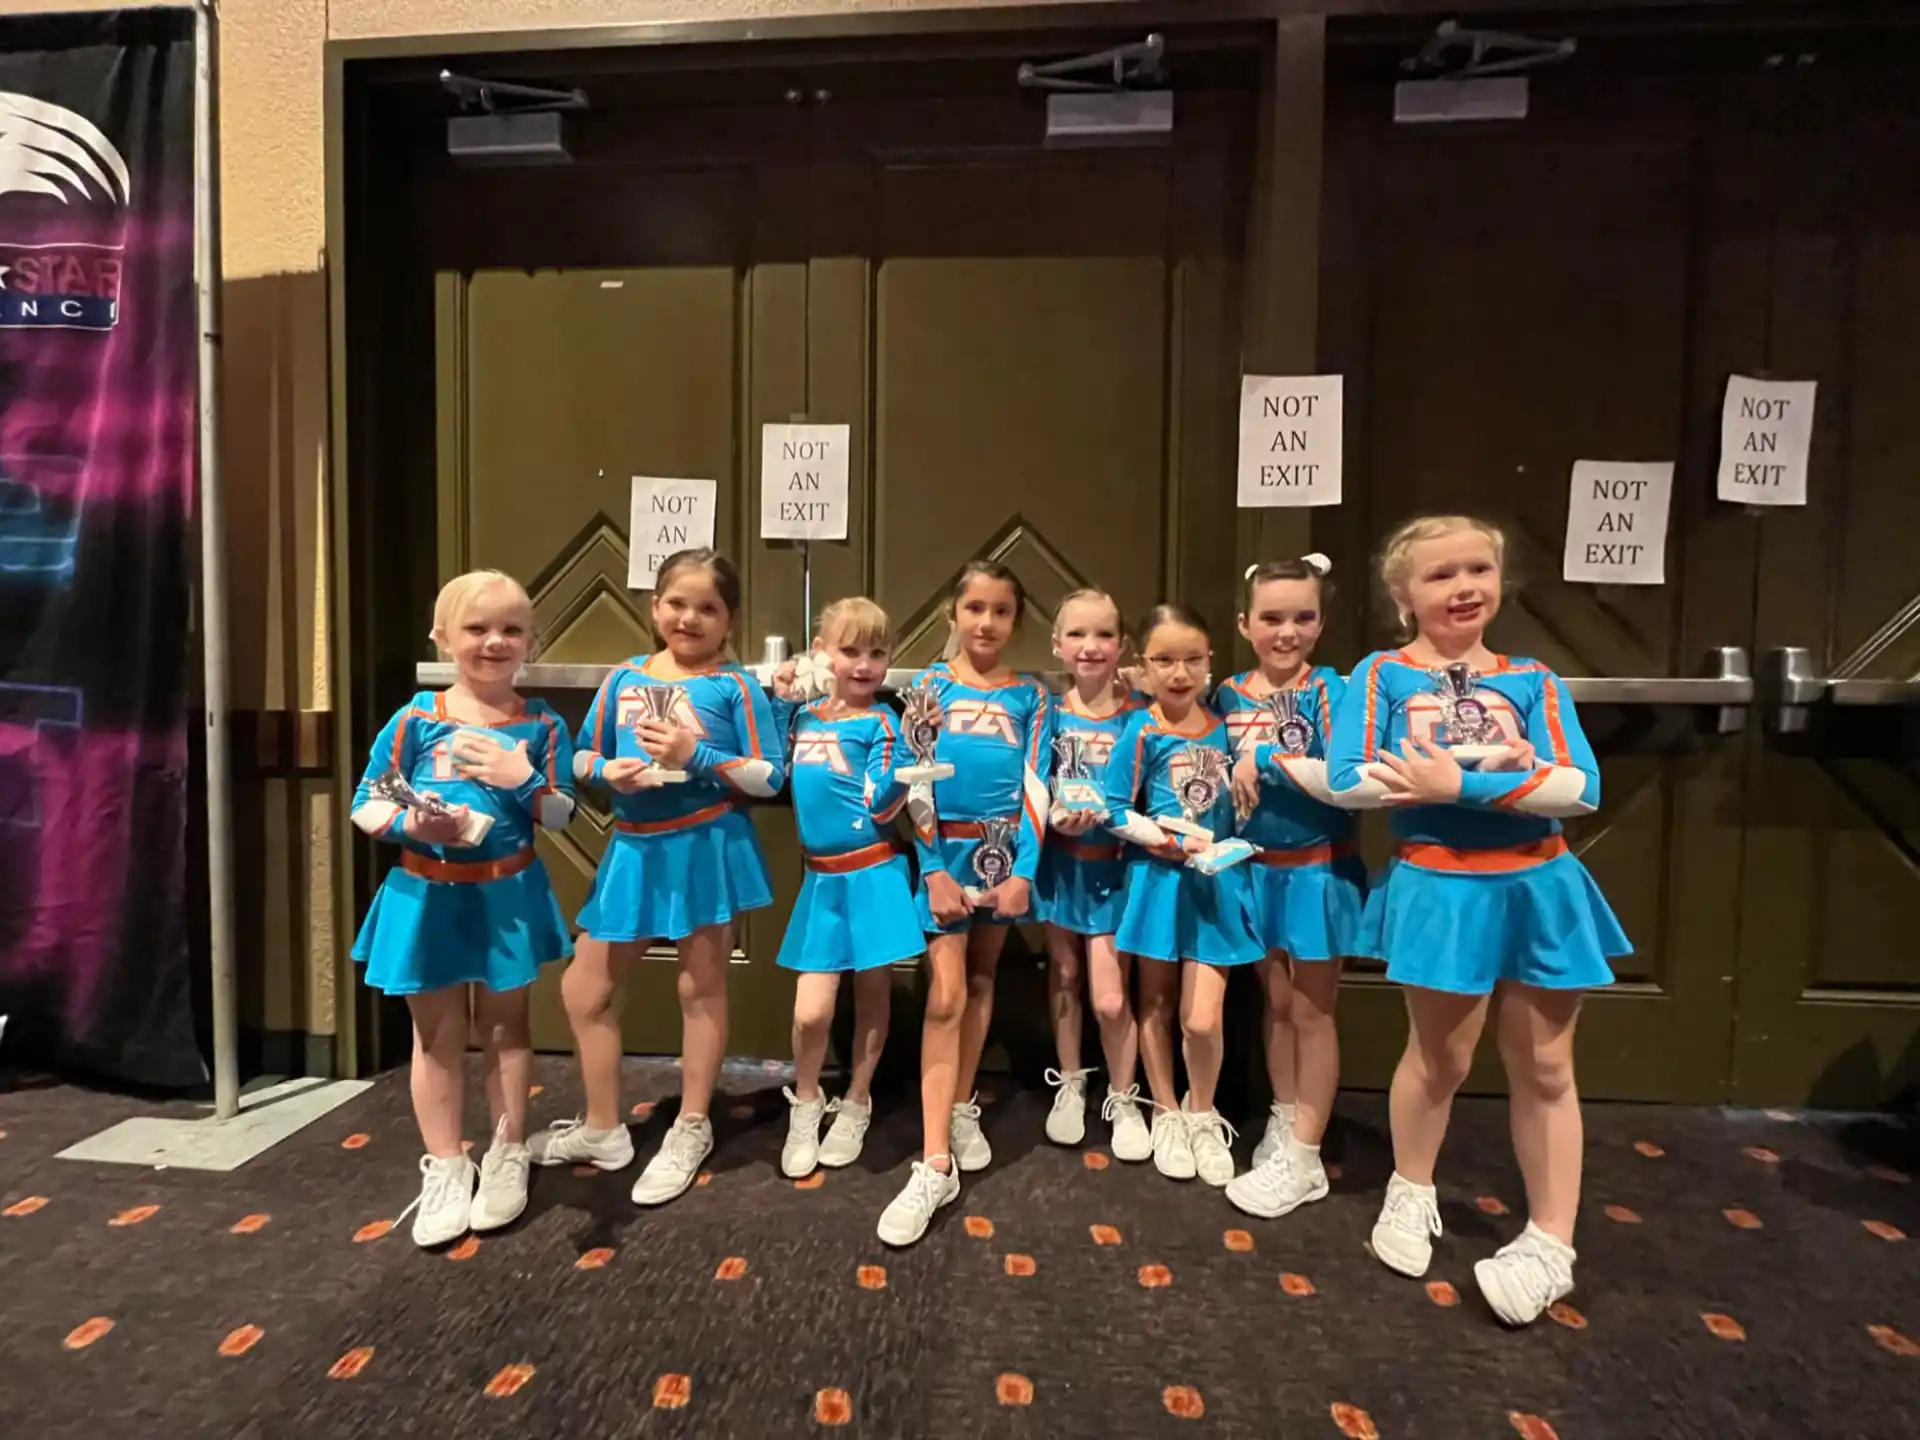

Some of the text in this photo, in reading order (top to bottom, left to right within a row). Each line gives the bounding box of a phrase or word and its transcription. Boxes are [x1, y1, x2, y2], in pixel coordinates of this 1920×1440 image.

[1263, 395, 1319, 418] NOT
[1741, 397, 1791, 420] NOT
[782, 441, 829, 460] NOT
[1270, 430, 1306, 452] AN
[1744, 432, 1777, 452] AN
[788, 472, 819, 491] AN
[1260, 464, 1320, 487] EXIT
[1734, 463, 1787, 486] EXIT
[1592, 479, 1647, 501] NOT
[651, 494, 697, 515] NOT
[779, 502, 829, 521] EXIT
[1597, 512, 1634, 532] AN
[656, 525, 687, 545] AN
[1585, 543, 1644, 566] EXIT
